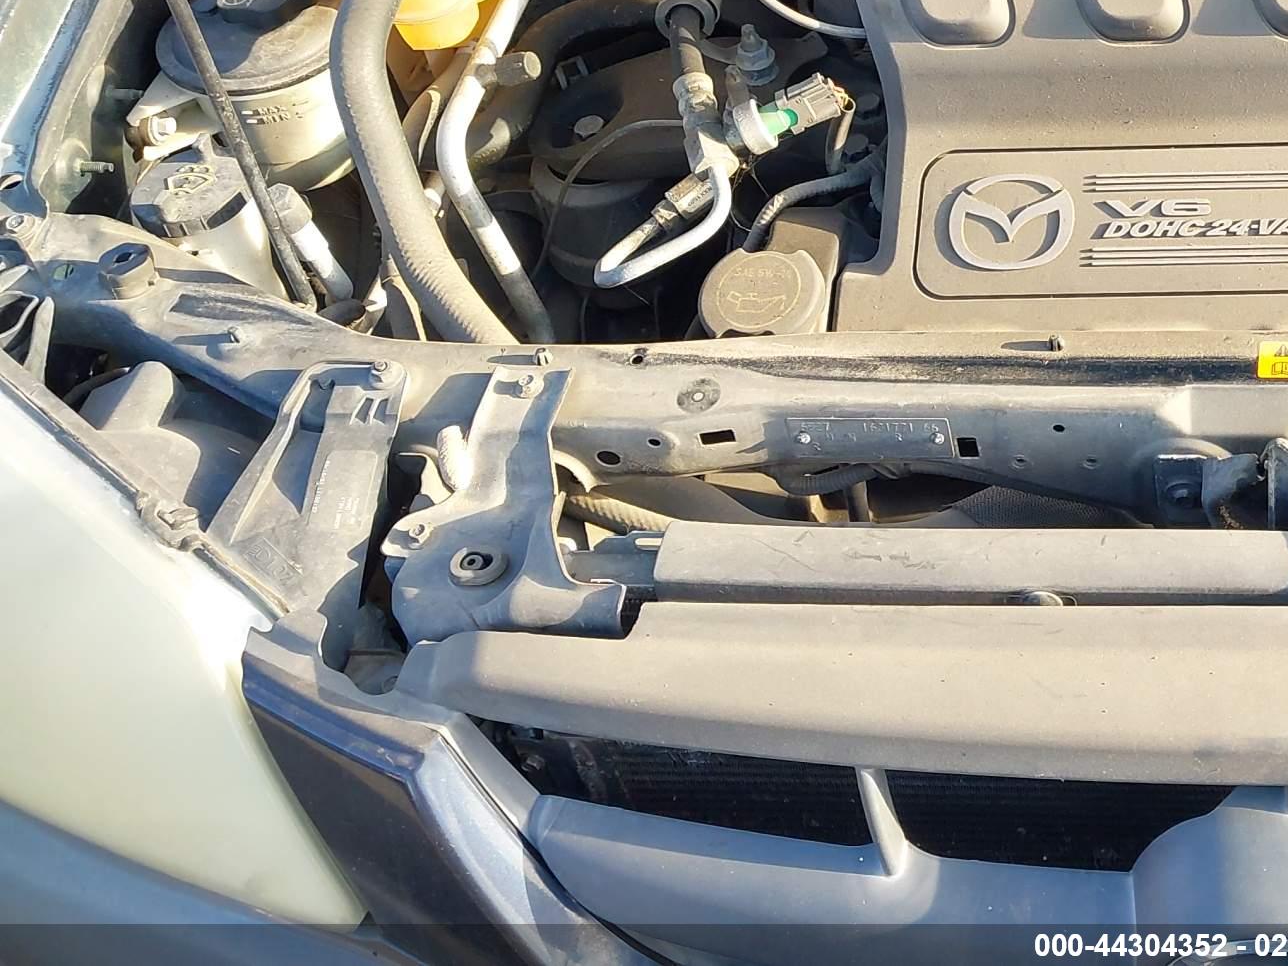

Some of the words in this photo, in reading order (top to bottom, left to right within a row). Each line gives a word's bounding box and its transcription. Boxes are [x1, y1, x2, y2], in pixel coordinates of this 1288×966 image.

[257, 105, 289, 116] MAX
[262, 113, 291, 124] MIN
[1102, 198, 1212, 218] V6
[1102, 218, 1201, 239] DOHC
